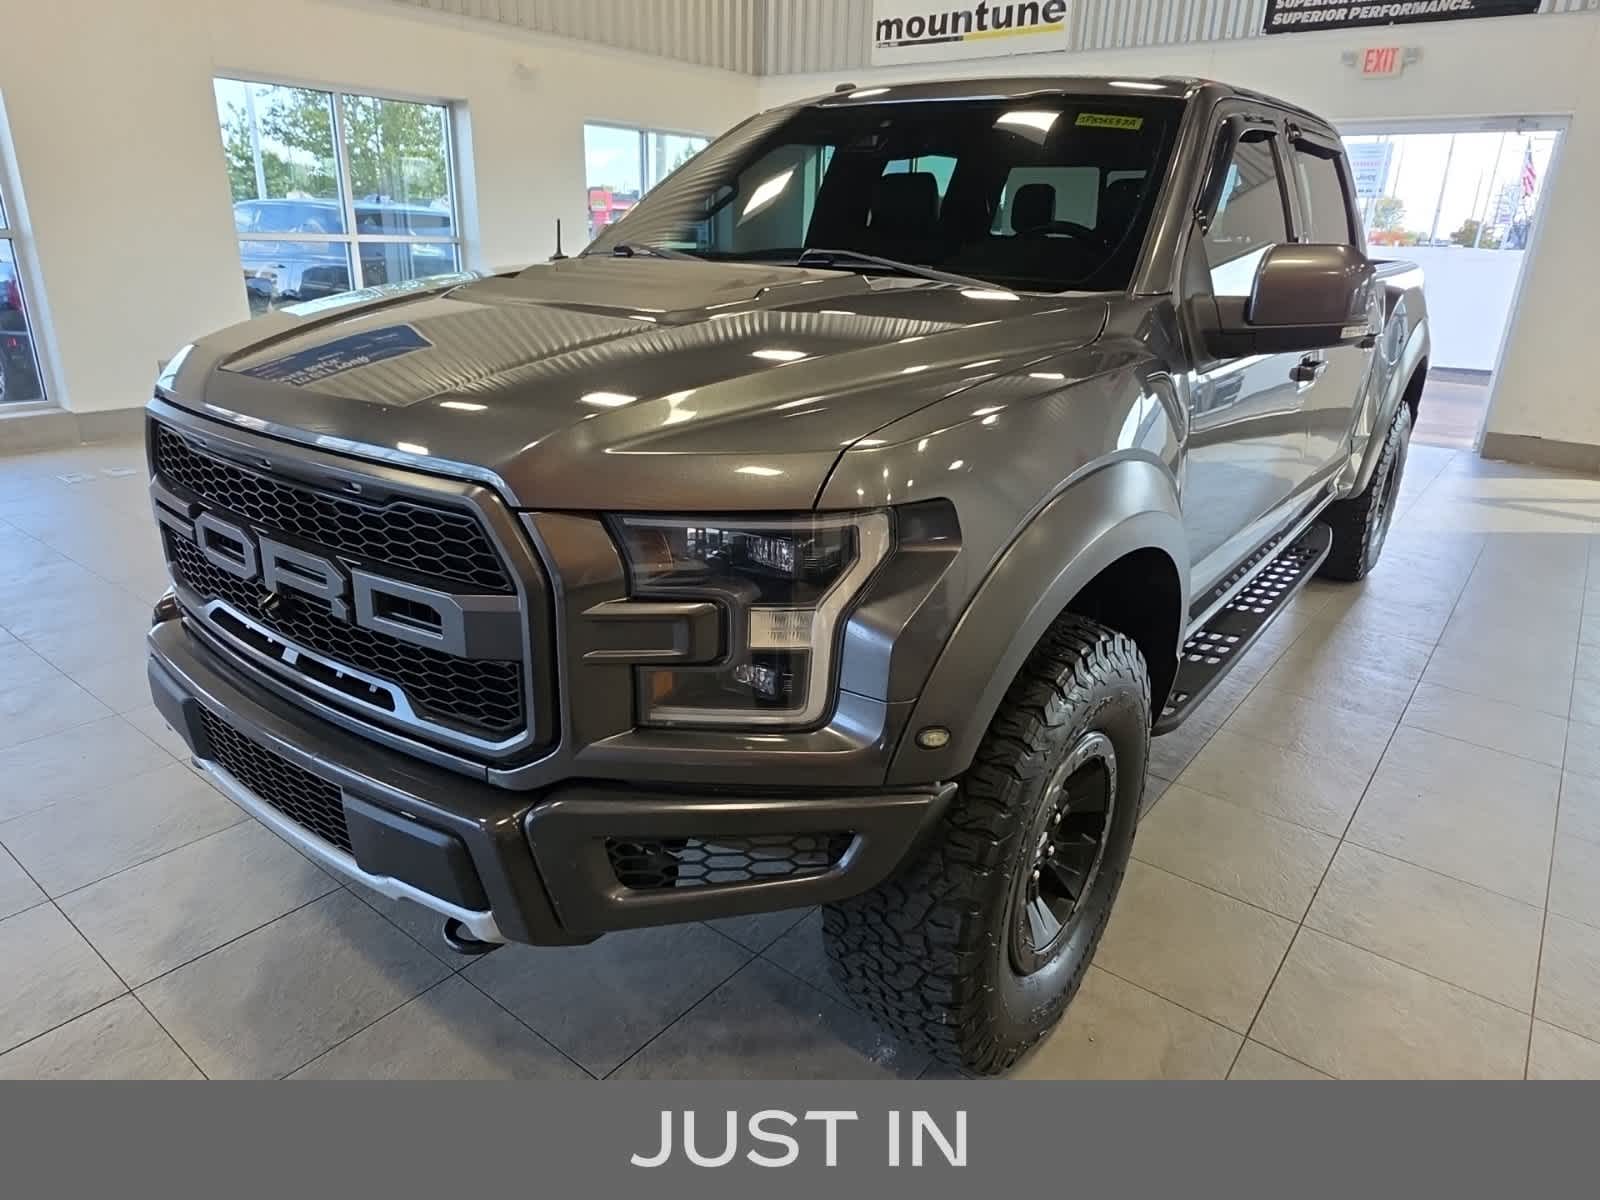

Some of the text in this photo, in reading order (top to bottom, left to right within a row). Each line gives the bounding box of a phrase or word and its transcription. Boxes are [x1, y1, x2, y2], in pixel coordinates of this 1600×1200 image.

[876, 0, 1067, 42] mountune
[1271, 0, 1475, 25] SUPERIOR PERFORMANCE.
[1363, 47, 1399, 74] EXIT
[152, 494, 468, 658] FORD
